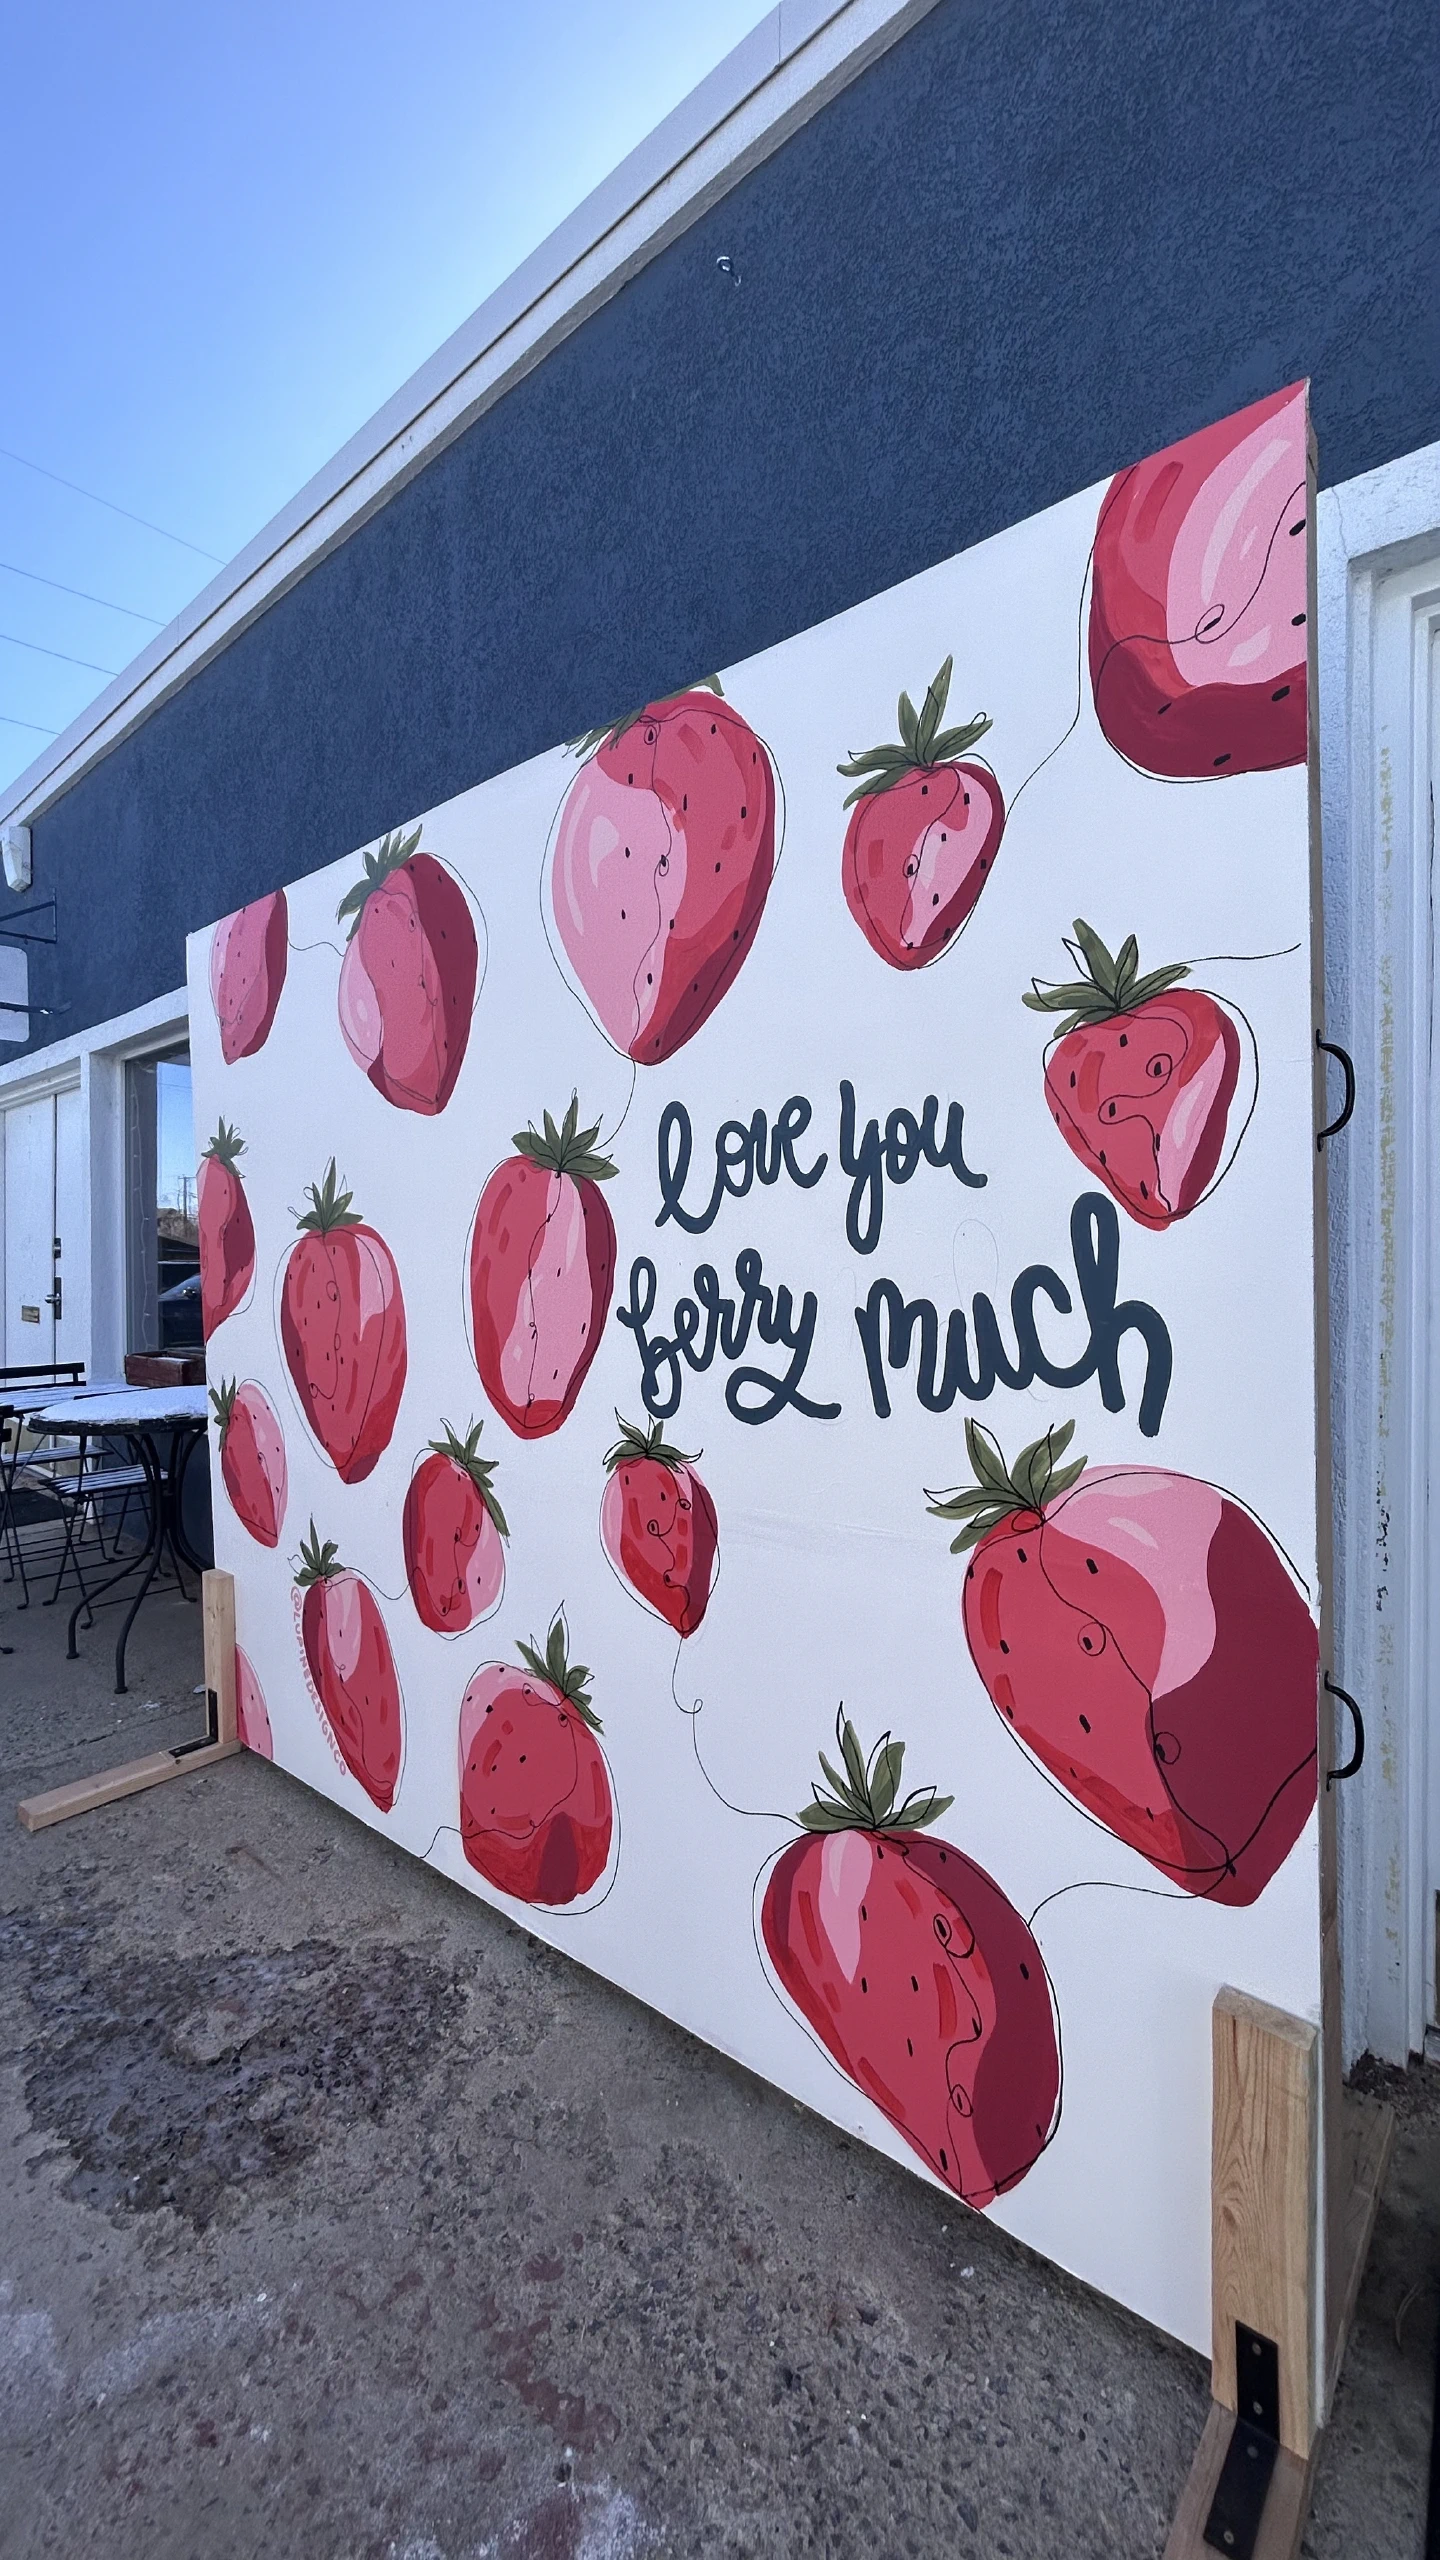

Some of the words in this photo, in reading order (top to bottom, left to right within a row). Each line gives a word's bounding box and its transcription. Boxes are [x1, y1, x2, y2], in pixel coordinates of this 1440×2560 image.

[655, 1095, 829, 1235] love
[839, 1079, 989, 1256] you
[616, 1247, 842, 1426] berry
[854, 1191, 1173, 1438] much
[290, 1585, 347, 1776] @LUPINEDESIGNCO
